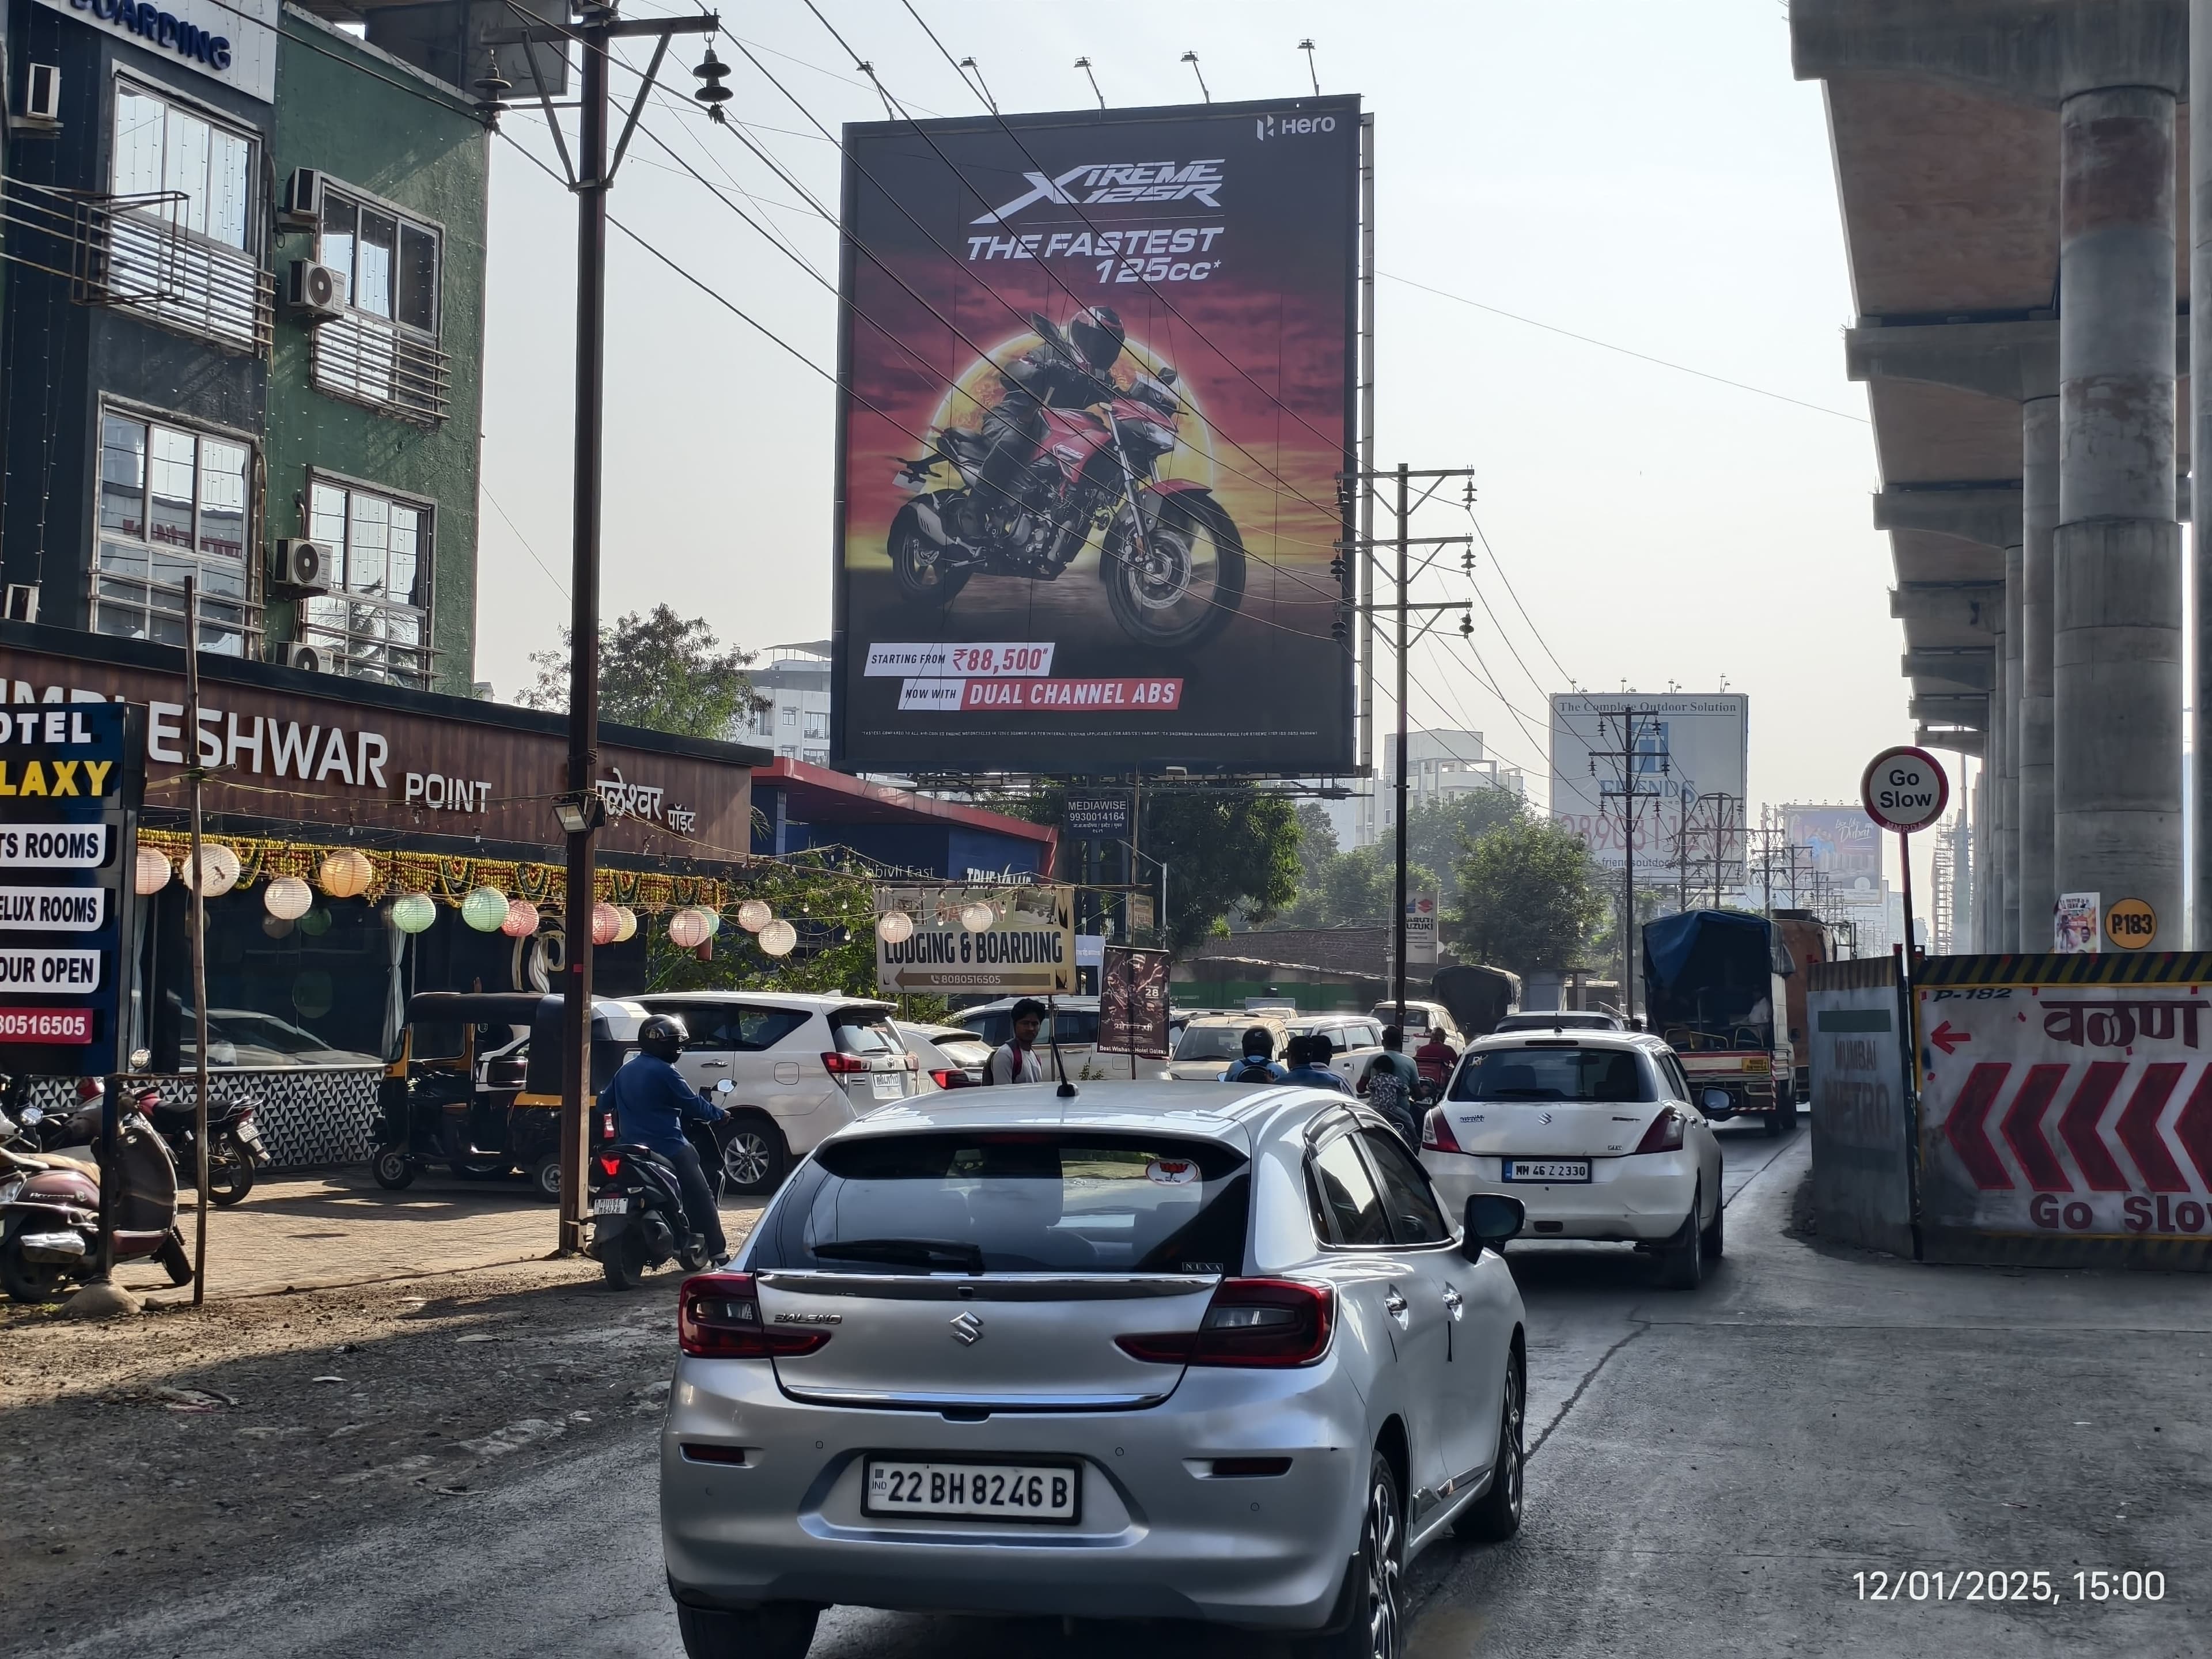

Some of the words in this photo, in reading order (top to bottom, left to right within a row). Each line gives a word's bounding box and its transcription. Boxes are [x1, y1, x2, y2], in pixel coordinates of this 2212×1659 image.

[1282, 116, 1335, 134] Hero
[969, 159, 1225, 224] XTREME
[1081, 184, 1222, 206] 125R
[968, 234, 1043, 260] THE
[1044, 228, 1225, 257] FASTEST
[872, 654, 917, 664] STARTING
[920, 654, 946, 664] FROM
[906, 689, 929, 698] NOW
[931, 690, 956, 698] WITH
[969, 684, 1023, 704] DUAL
[1030, 683, 1125, 704] CHANNEL
[1131, 683, 1175, 703] ABS
[1559, 702, 1581, 712] The
[1584, 701, 1636, 714] Complee
[1640, 702, 1687, 712] Outdoor
[1690, 702, 1736, 712] Solution
[1889, 769, 1919, 786] Go
[406, 772, 491, 813] POINT
[1880, 791, 1932, 808] Slow
[1068, 801, 1126, 810] MEDIAWISE
[1070, 812, 1125, 821] 9930014164
[25, 832, 99, 859] ROOMS
[907, 865, 935, 877] East
[40, 896, 97, 923] ROOMS
[885, 932, 954, 964] LODGING
[960, 932, 971, 963] &
[975, 931, 1063, 964] BOARDING
[41, 957, 94, 983] OPEN
[1145, 988, 1158, 997] 28
[1934, 988, 2012, 1002] P-182
[2040, 1001, 2211, 1050] वळण
[1835, 1039, 1876, 1071] MUMBAI
[1533, 1165, 1546, 1176] 46
[1550, 1166, 1555, 1176] Z
[1559, 1166, 1585, 1176] 2330
[2030, 1194, 2093, 1229] Go
[872, 1480, 887, 1490] IND
[888, 1471, 922, 1502] 22
[931, 1472, 964, 1504] BH
[972, 1475, 1043, 1507] 8246
[1052, 1476, 1067, 1508] B
